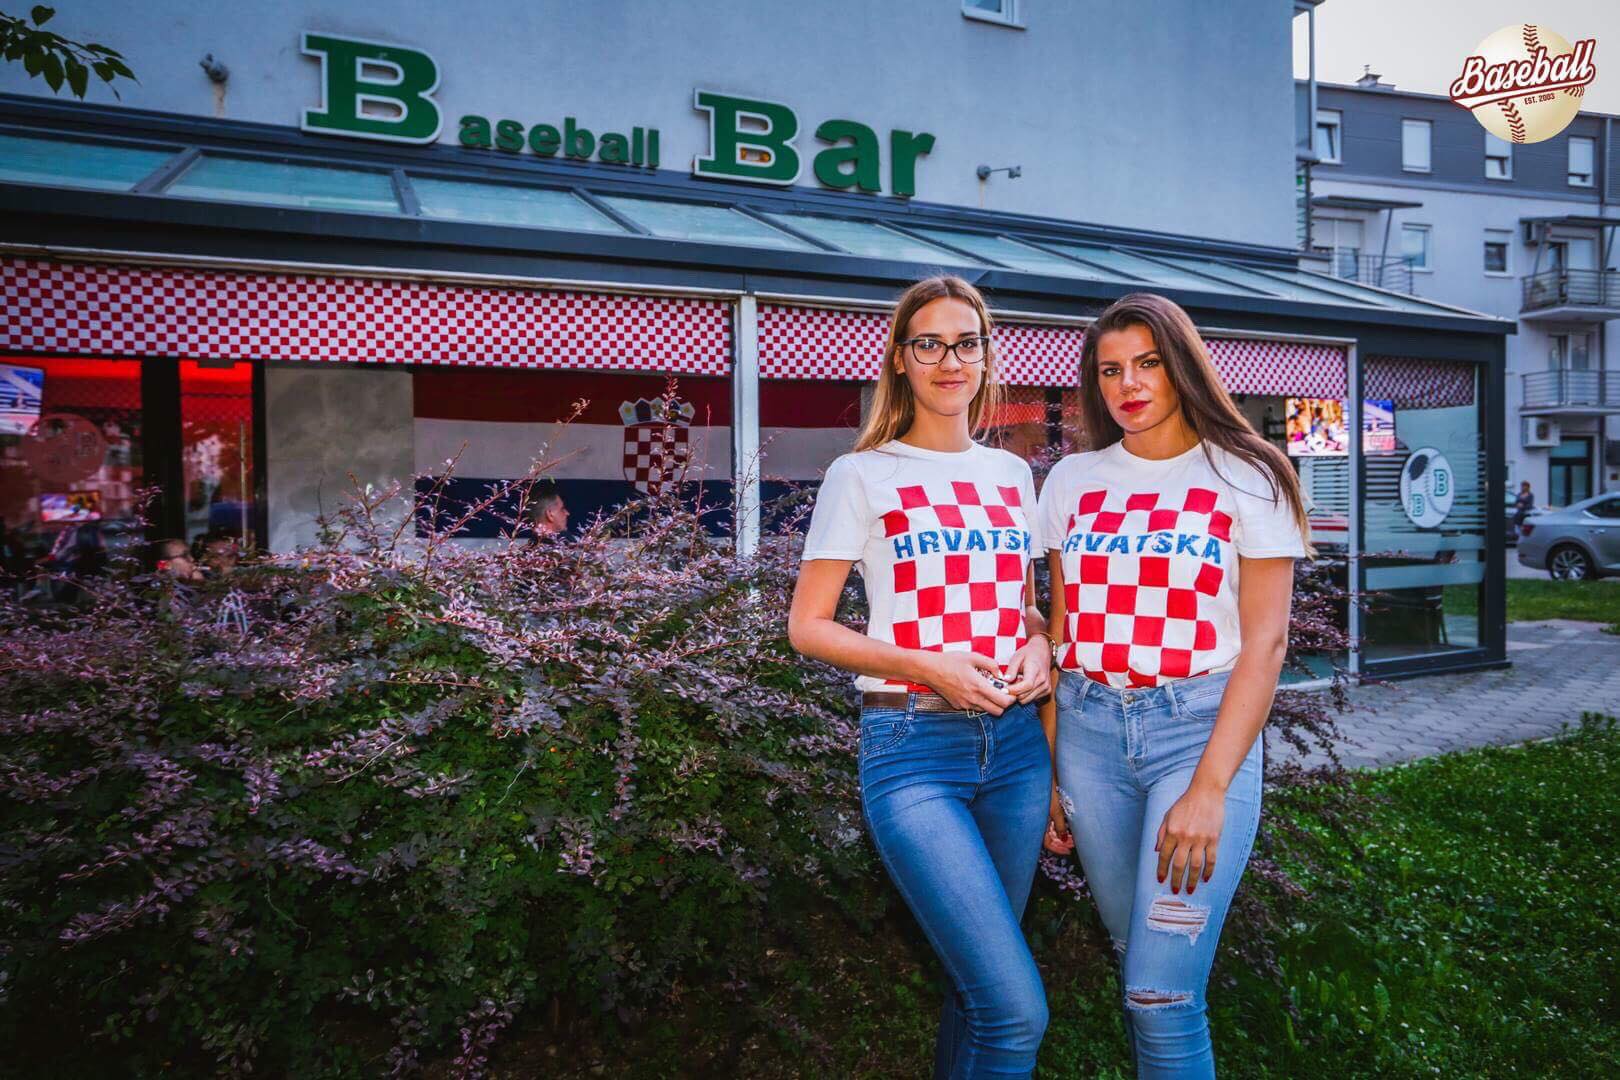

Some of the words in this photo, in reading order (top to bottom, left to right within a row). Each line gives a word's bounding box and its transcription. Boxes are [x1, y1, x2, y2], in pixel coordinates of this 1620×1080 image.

[693, 87, 936, 197] Bar
[1433, 468, 1449, 497] B
[1062, 531, 1221, 564] RVATSKA
